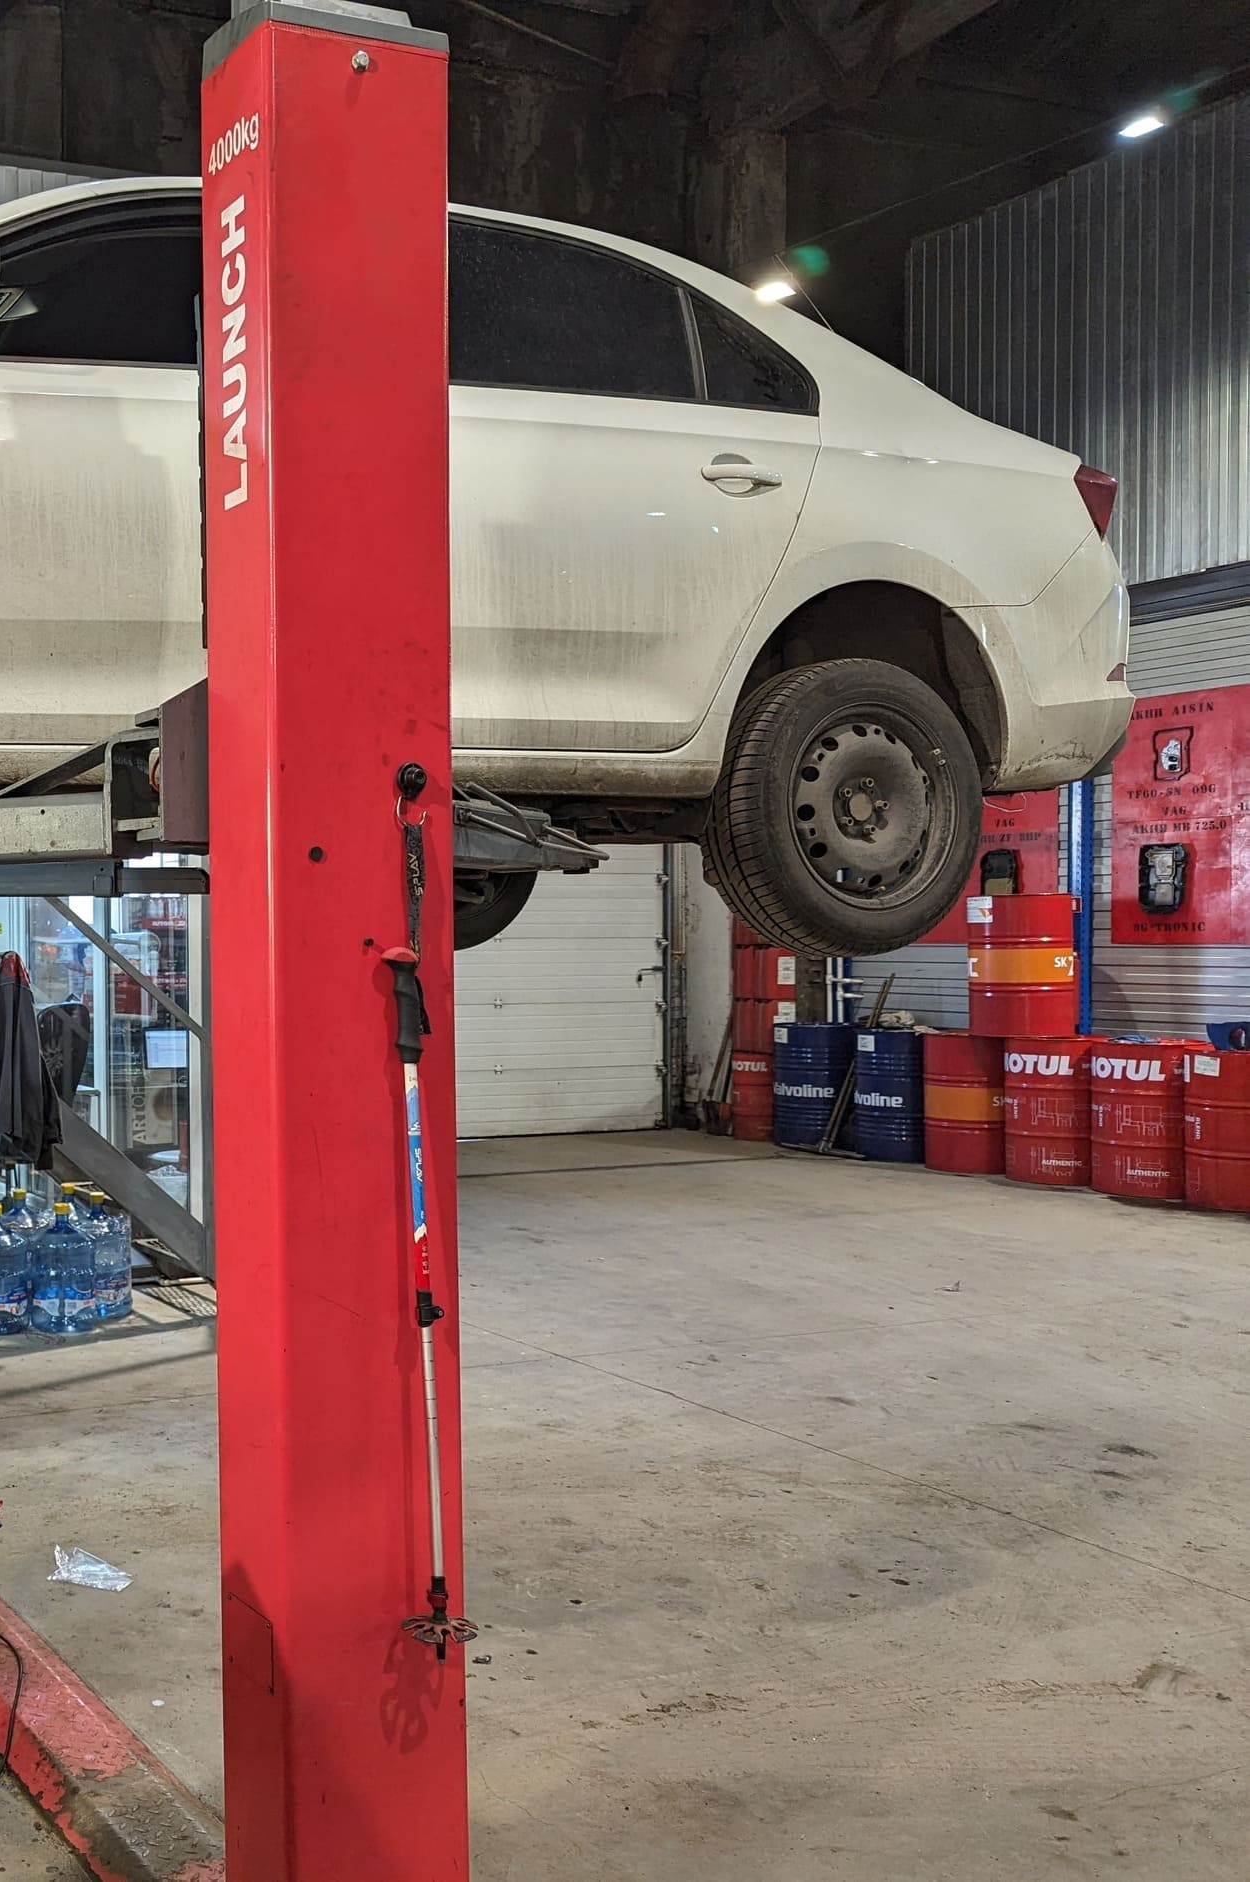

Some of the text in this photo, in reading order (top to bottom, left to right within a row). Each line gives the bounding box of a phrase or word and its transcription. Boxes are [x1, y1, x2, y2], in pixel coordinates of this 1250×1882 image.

[207, 111, 261, 177] 4000kg
[221, 195, 249, 511] LAUNCH
[1172, 702, 1215, 716] AISIN
[1161, 806, 1187, 816] VAG
[994, 818, 1015, 828] VAG
[1195, 820, 1227, 831] 725.0
[407, 853, 424, 896] SPLAV
[1054, 956, 1067, 968] SK
[854, 1090, 904, 1108] lvoline
[414, 1148, 423, 1182] SPLAV
[1126, 1168, 1171, 1177] AUTHENTIC
